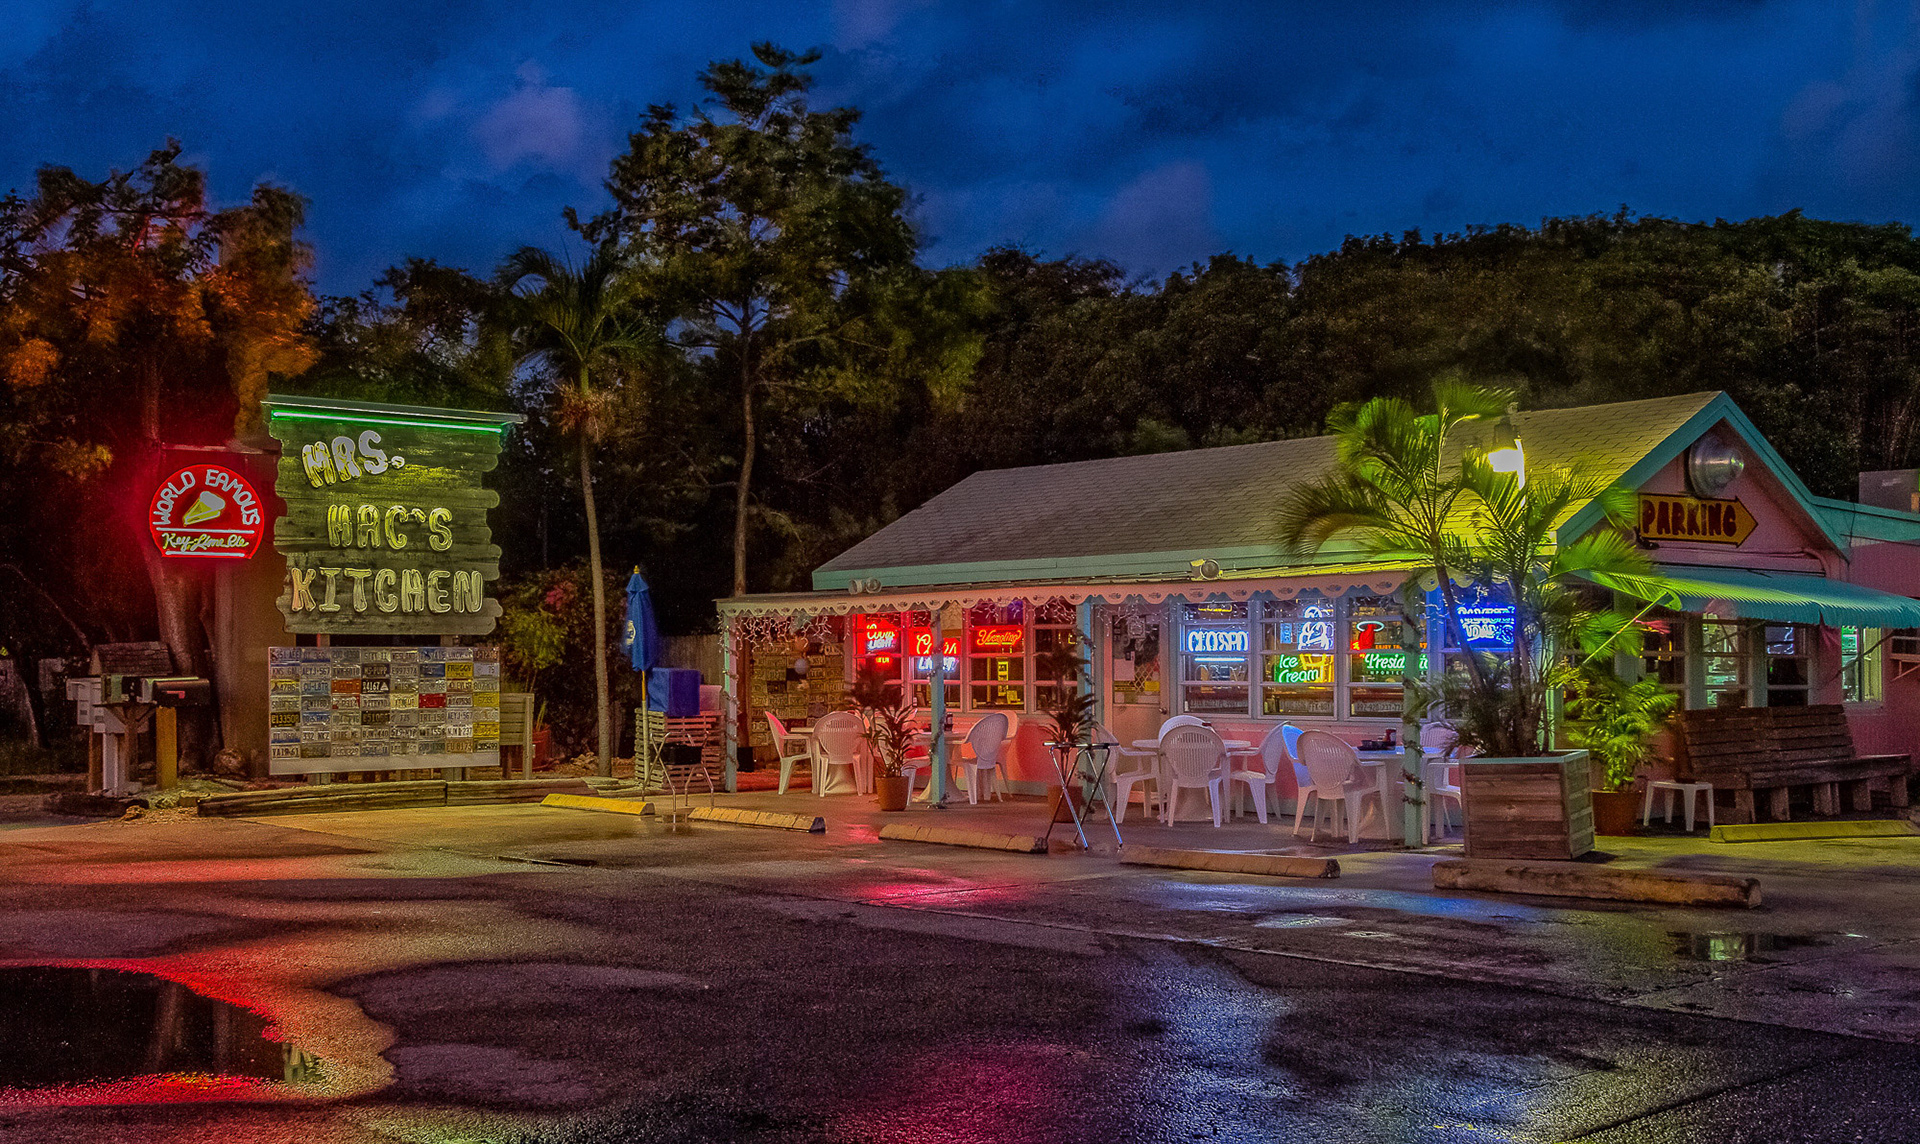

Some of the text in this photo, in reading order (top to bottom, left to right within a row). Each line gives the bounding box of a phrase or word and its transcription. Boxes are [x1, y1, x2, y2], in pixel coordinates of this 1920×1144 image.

[302, 429, 405, 488] MRS.
[152, 471, 196, 525] WORLD
[1642, 500, 1737, 537] PARKING
[327, 504, 453, 551] MAC'S
[291, 567, 483, 613] KITCHEN
[1278, 669, 1319, 683] Cream
[1279, 654, 1299, 669] Ice
